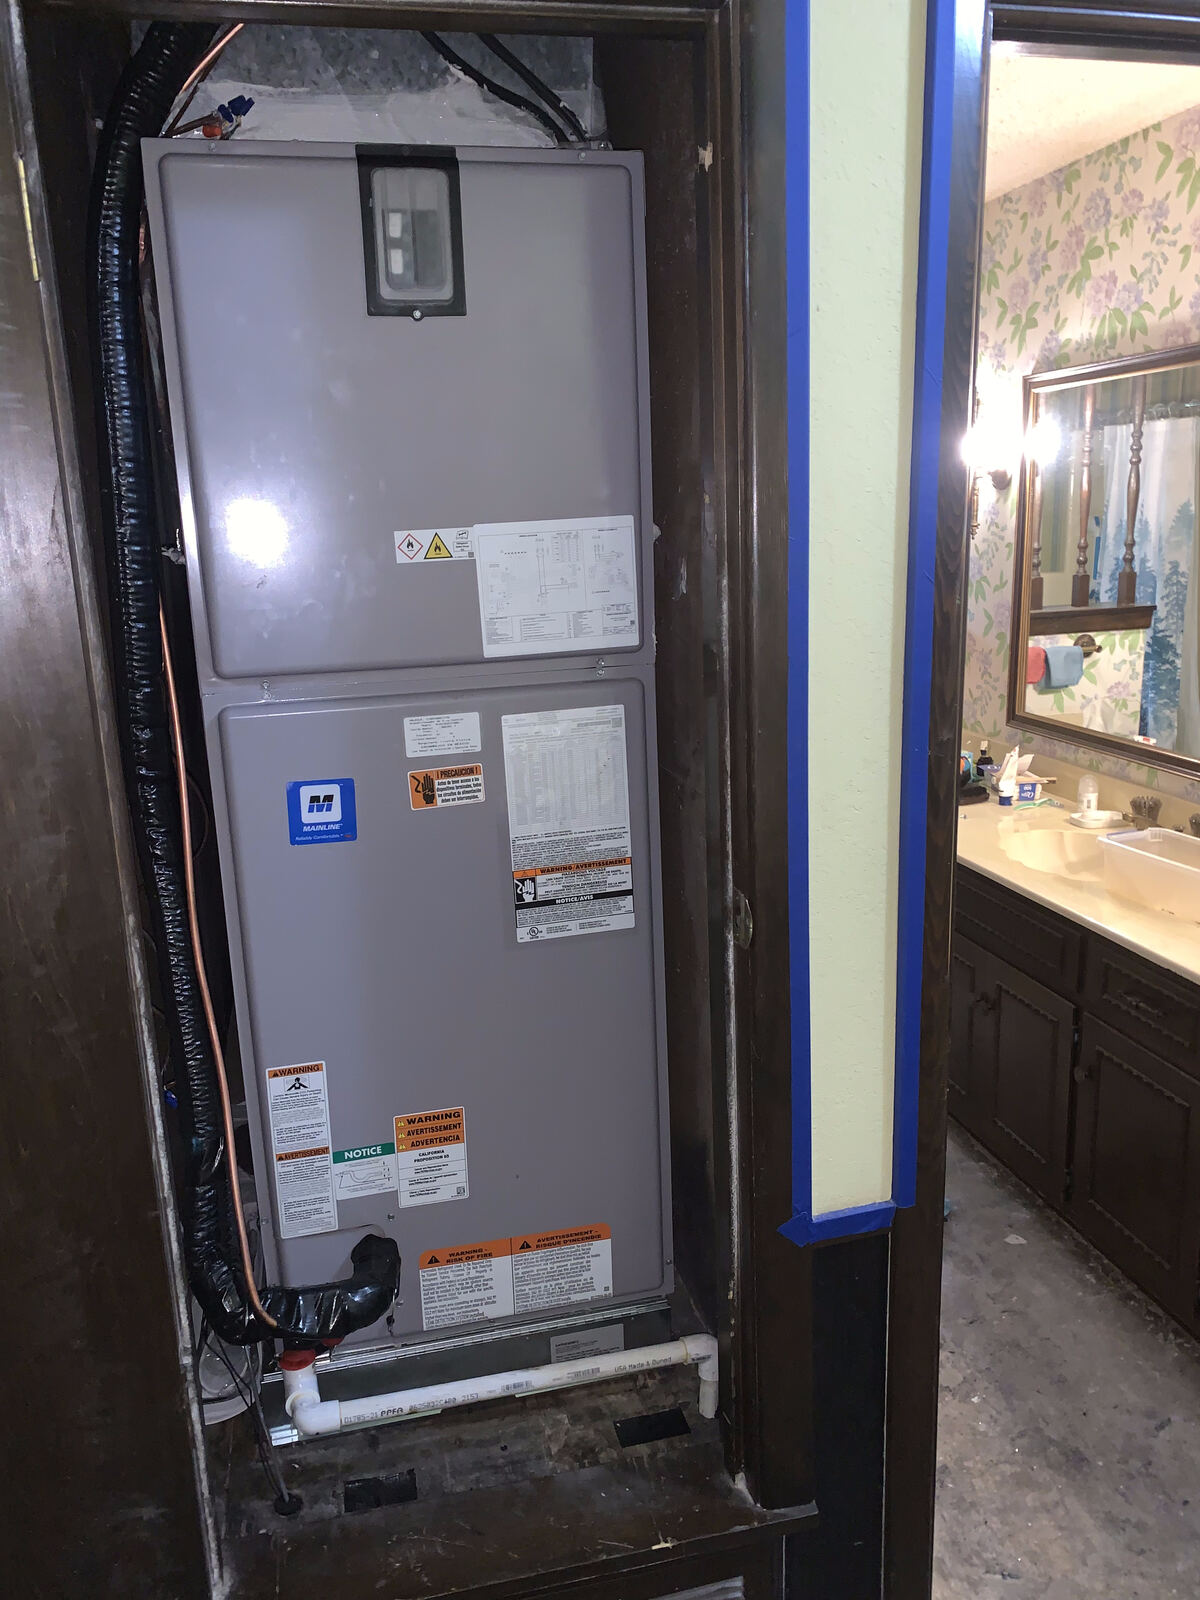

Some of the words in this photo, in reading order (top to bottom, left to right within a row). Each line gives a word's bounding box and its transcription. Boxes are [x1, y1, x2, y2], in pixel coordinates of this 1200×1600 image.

[303, 824, 341, 832] MAINLINE
[556, 895, 594, 904] NOTICE/AVIS
[279, 1065, 319, 1076] WARNING
[406, 1112, 460, 1125] WARNING
[407, 1122, 462, 1136] AVERTISSEMENT
[410, 1135, 460, 1147] ADVERTENCIA
[284, 1149, 329, 1160] AVERTISSEMENT
[344, 1146, 382, 1159] NOTICE
[449, 1248, 483, 1257] WARNING
